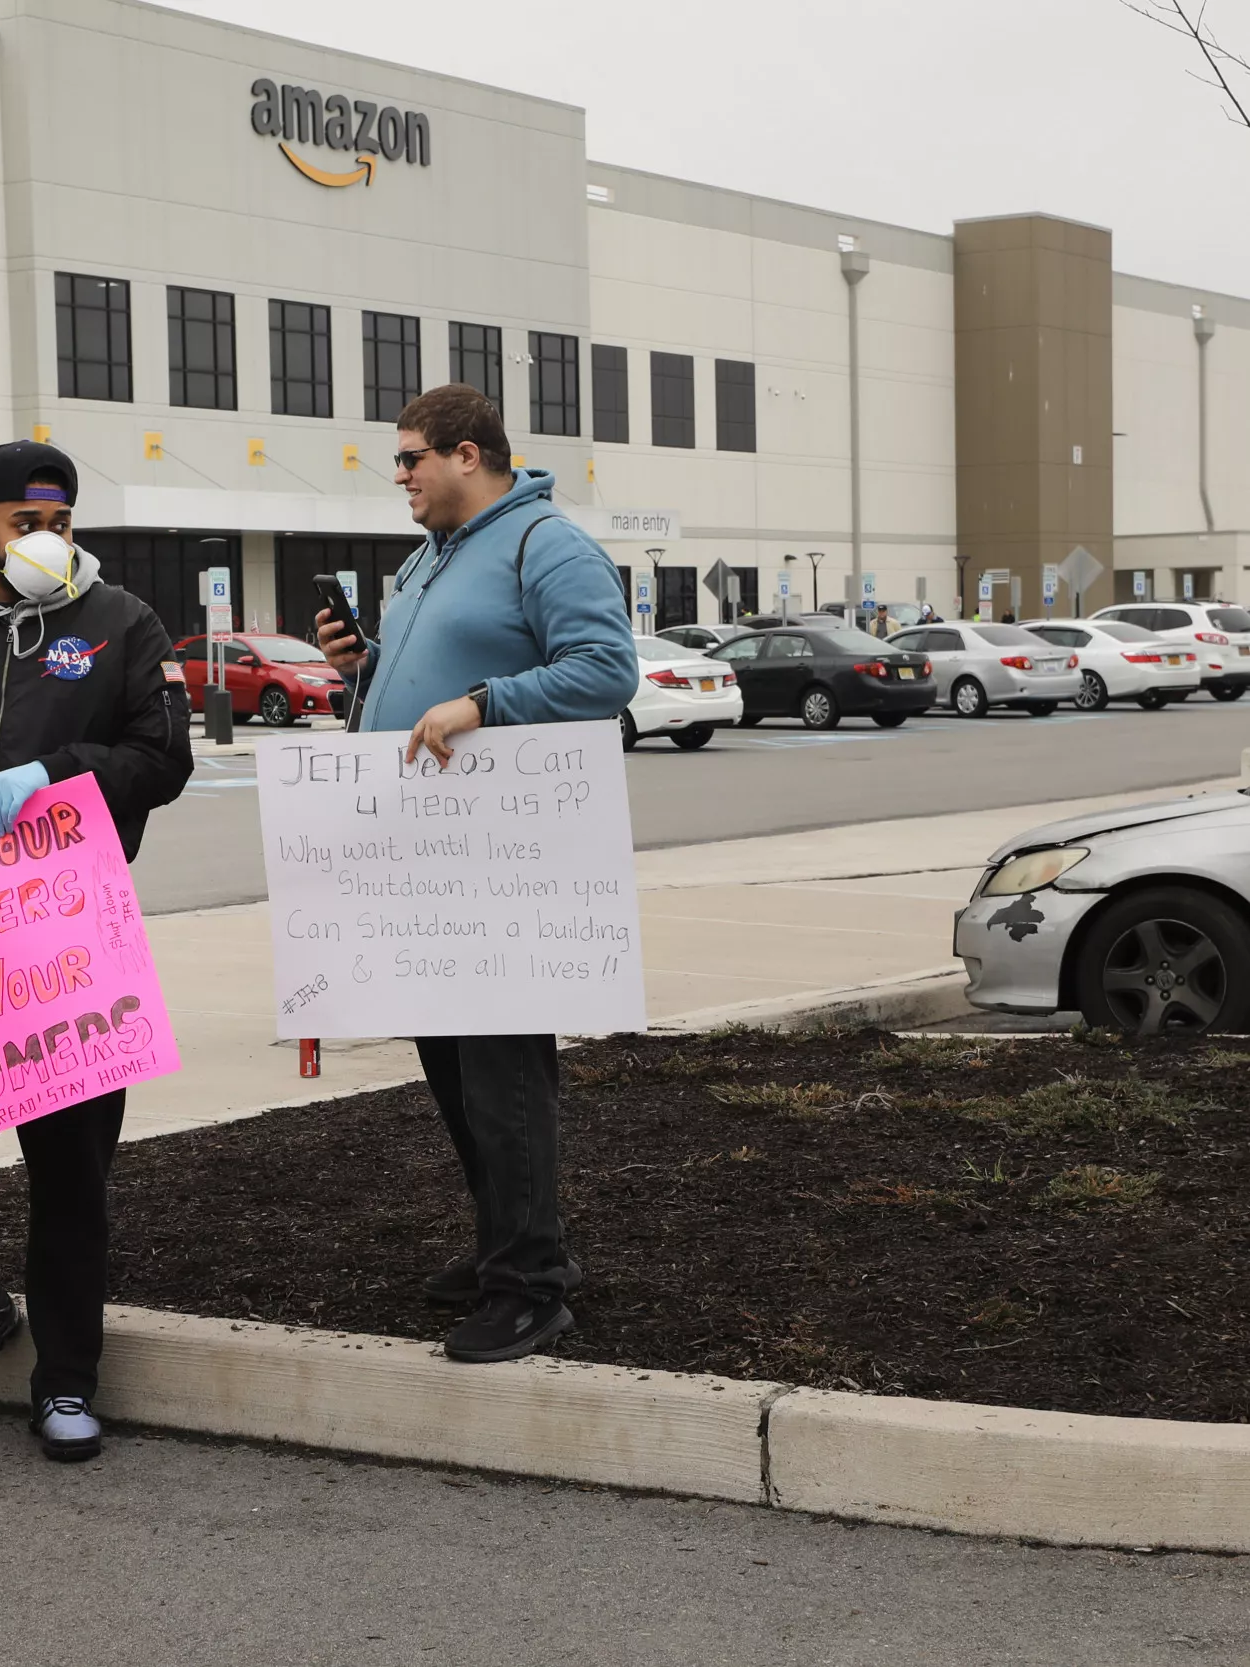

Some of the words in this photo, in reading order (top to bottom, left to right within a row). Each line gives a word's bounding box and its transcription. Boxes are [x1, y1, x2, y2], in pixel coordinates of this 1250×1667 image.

[251, 78, 431, 167] amazon
[611, 512, 640, 530] main
[643, 513, 670, 536] entry
[46, 649, 92, 667] NASA
[279, 745, 372, 787] JEFF
[516, 738, 582, 775] Can
[401, 785, 480, 818] hear
[279, 835, 333, 872] Why
[343, 836, 403, 861] wait
[415, 833, 469, 857] until
[487, 832, 541, 860] lives
[574, 880, 619, 907] you
[287, 909, 340, 942] Can
[506, 921, 520, 938] a
[537, 909, 630, 953] building
[352, 954, 373, 983] &
[475, 953, 506, 977] all
[282, 974, 329, 1015] #JFK8
[46, 1078, 85, 1106] STAY
